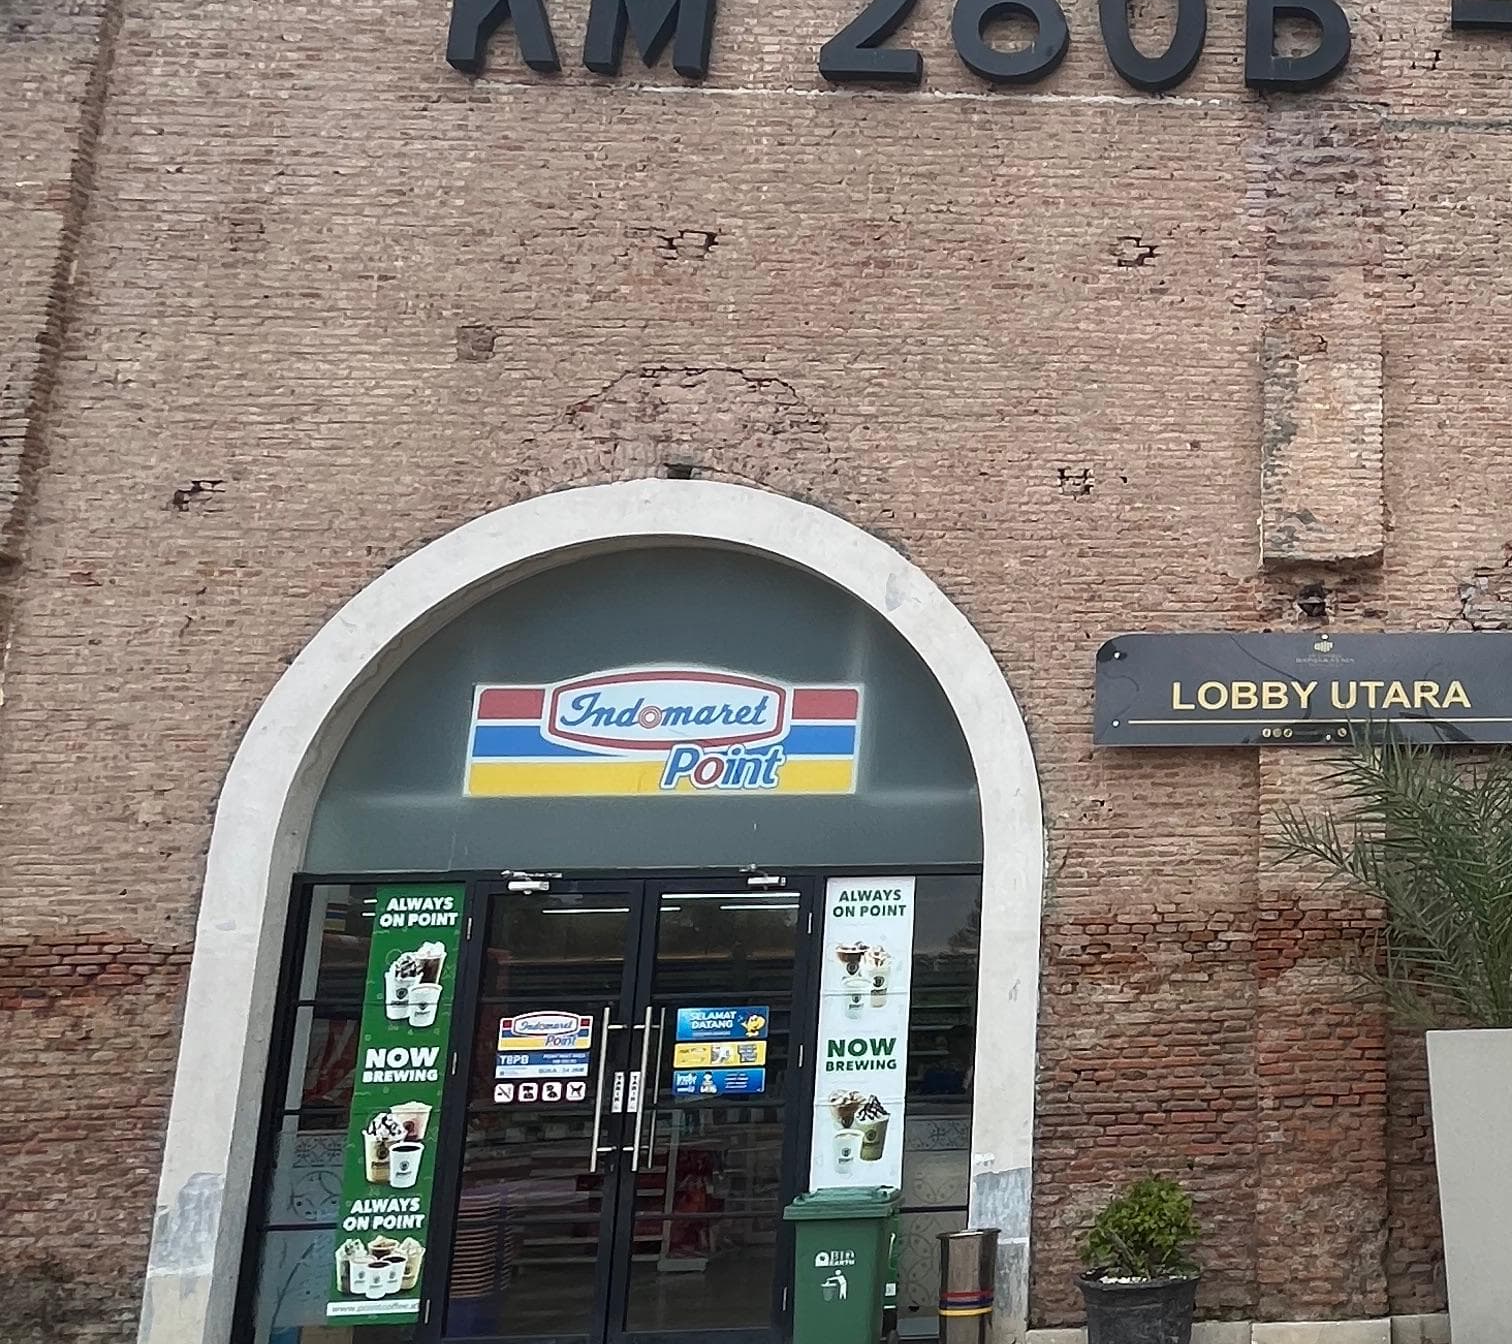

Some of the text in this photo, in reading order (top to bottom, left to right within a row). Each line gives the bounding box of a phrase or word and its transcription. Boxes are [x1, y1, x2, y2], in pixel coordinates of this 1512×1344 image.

[1171, 679, 1472, 711] LOBBY UTARA
[560, 691, 769, 729] Indomaret
[663, 745, 783, 788] Point
[838, 889, 902, 902] ALWAYS
[386, 897, 454, 911] ALWAYS
[833, 905, 907, 918] ON POINT
[379, 912, 458, 928] ON POINT
[690, 1011, 737, 1020] SELAMAT
[691, 1020, 734, 1030] DATANG
[827, 1038, 896, 1058] NOW
[365, 1047, 440, 1069] NOW
[826, 1059, 897, 1072] BREWING
[362, 1069, 438, 1083] BREWING
[350, 1198, 421, 1214] ALWAYS
[342, 1215, 426, 1232] ON POINT
